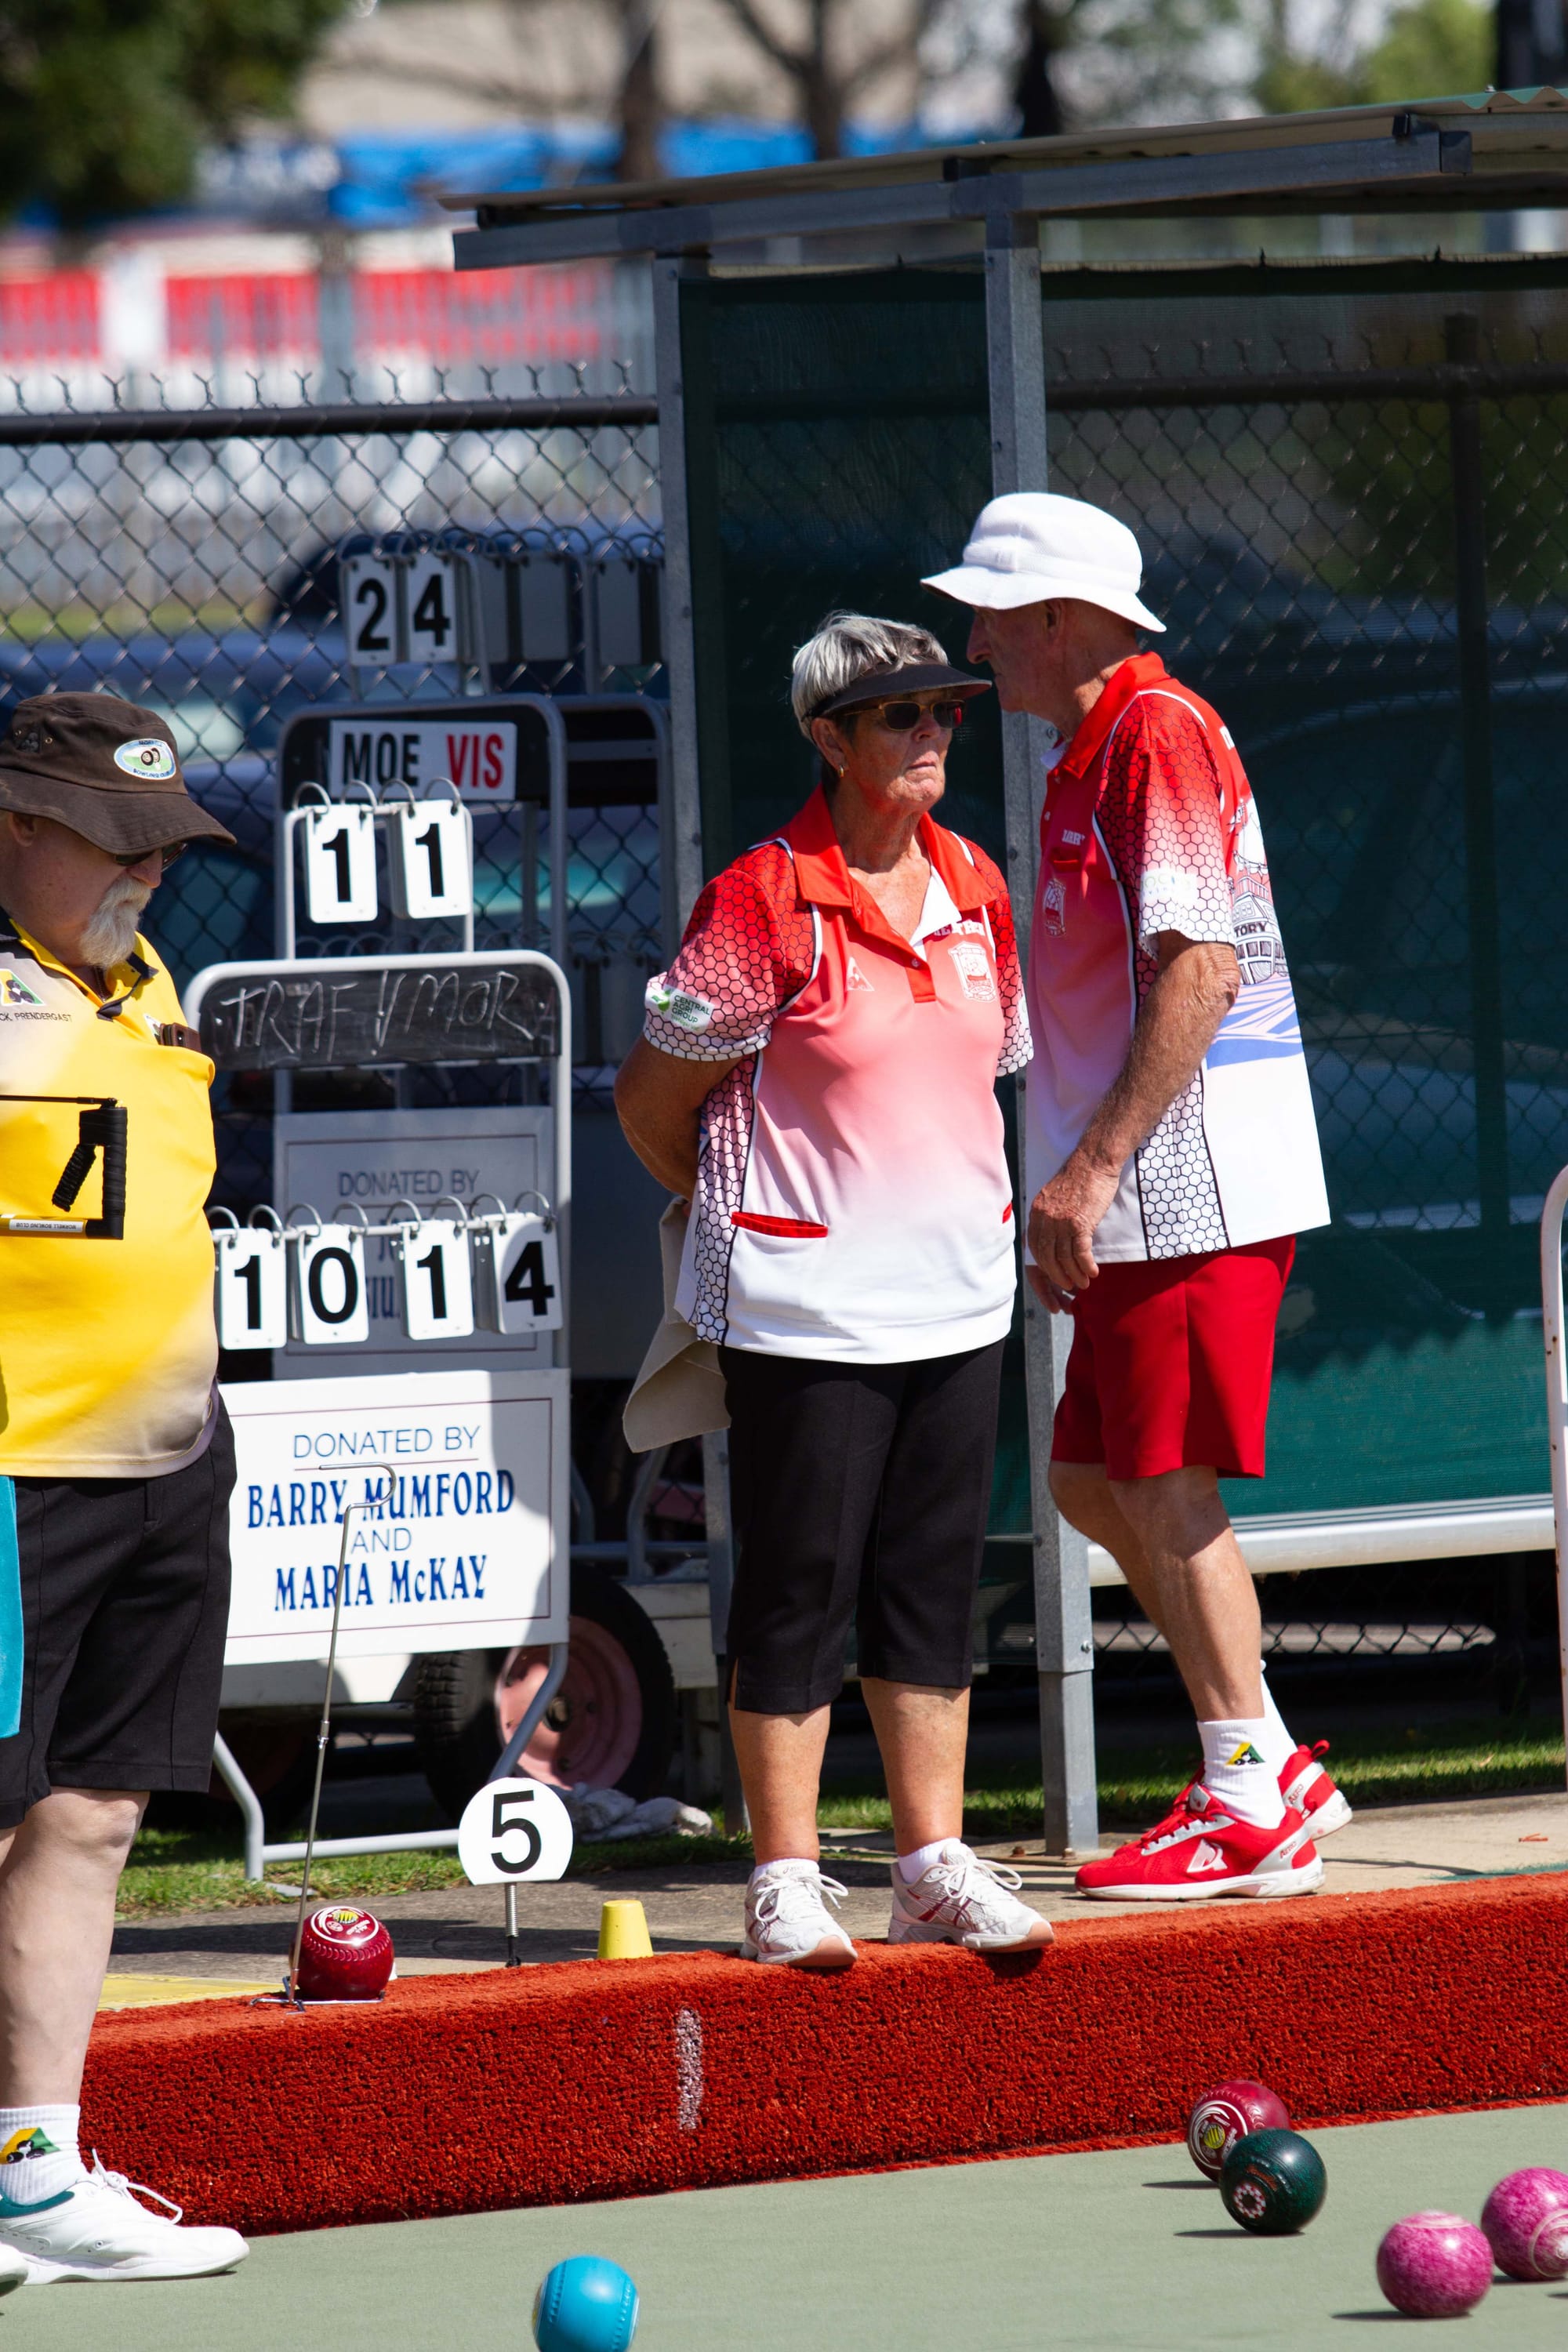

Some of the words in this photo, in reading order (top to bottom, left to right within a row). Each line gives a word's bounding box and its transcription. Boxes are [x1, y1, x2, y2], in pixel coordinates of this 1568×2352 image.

[343, 733, 421, 786] MOE
[446, 733, 504, 789] VIS
[14, 1011, 72, 1022] PRENDERGAST
[672, 1007, 699, 1022] GROUP
[673, 1002, 693, 1014] AGRI
[674, 995, 710, 1015] CENTRAL
[338, 1170, 443, 1196] DONATED
[451, 1170, 480, 1193] BY
[294, 1428, 433, 1458] DONATED
[445, 1425, 481, 1451] BY
[248, 1479, 347, 1528] BARRY
[363, 1469, 514, 1522] MUMFORD
[350, 1527, 412, 1554] AND
[274, 1562, 374, 1612] MARIA
[390, 1555, 488, 1604] McKAY
[491, 1790, 542, 1874] 5
